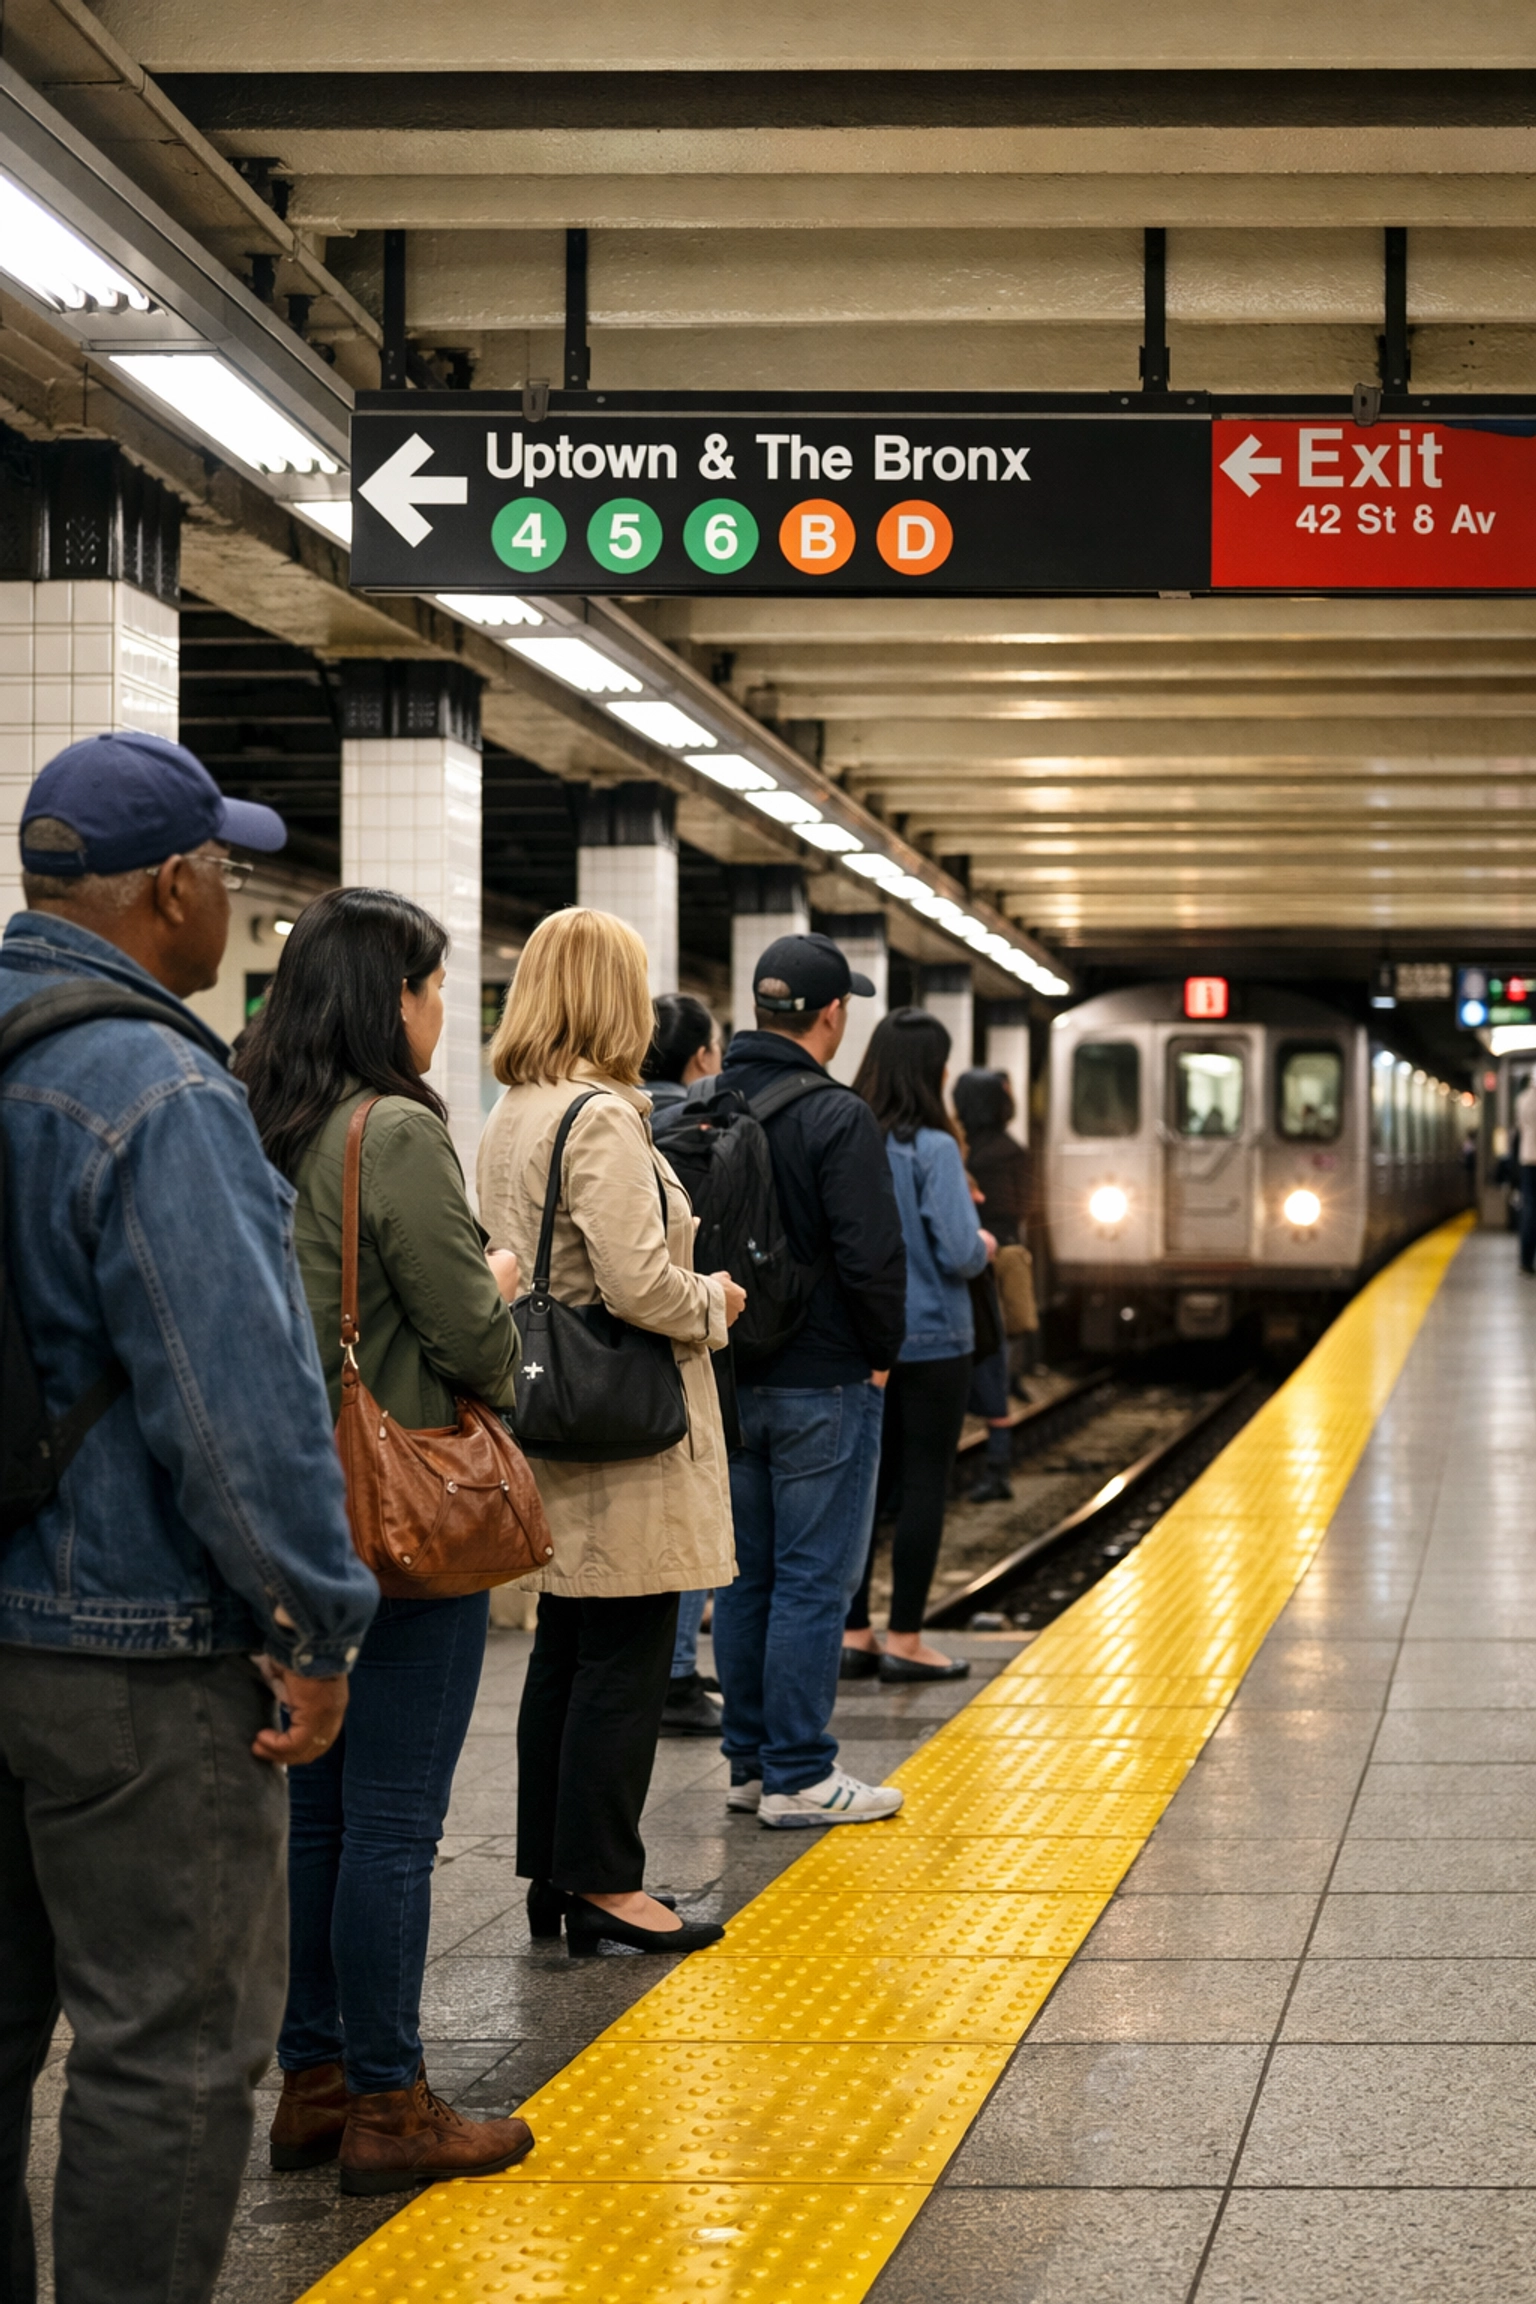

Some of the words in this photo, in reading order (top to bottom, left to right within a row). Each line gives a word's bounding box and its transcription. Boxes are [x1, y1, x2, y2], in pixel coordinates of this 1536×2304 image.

[486, 431, 677, 488] Uptown
[698, 433, 737, 480] &
[755, 433, 853, 481] The
[874, 434, 1031, 482] Bronx
[1298, 428, 1443, 488] Exit
[511, 512, 547, 558] 4
[608, 512, 643, 560] 5
[704, 513, 739, 561] 6
[800, 514, 837, 559] B
[898, 515, 935, 560] D
[1295, 503, 1341, 534] 42
[1357, 503, 1396, 535] St
[1450, 504, 1496, 534] Av
